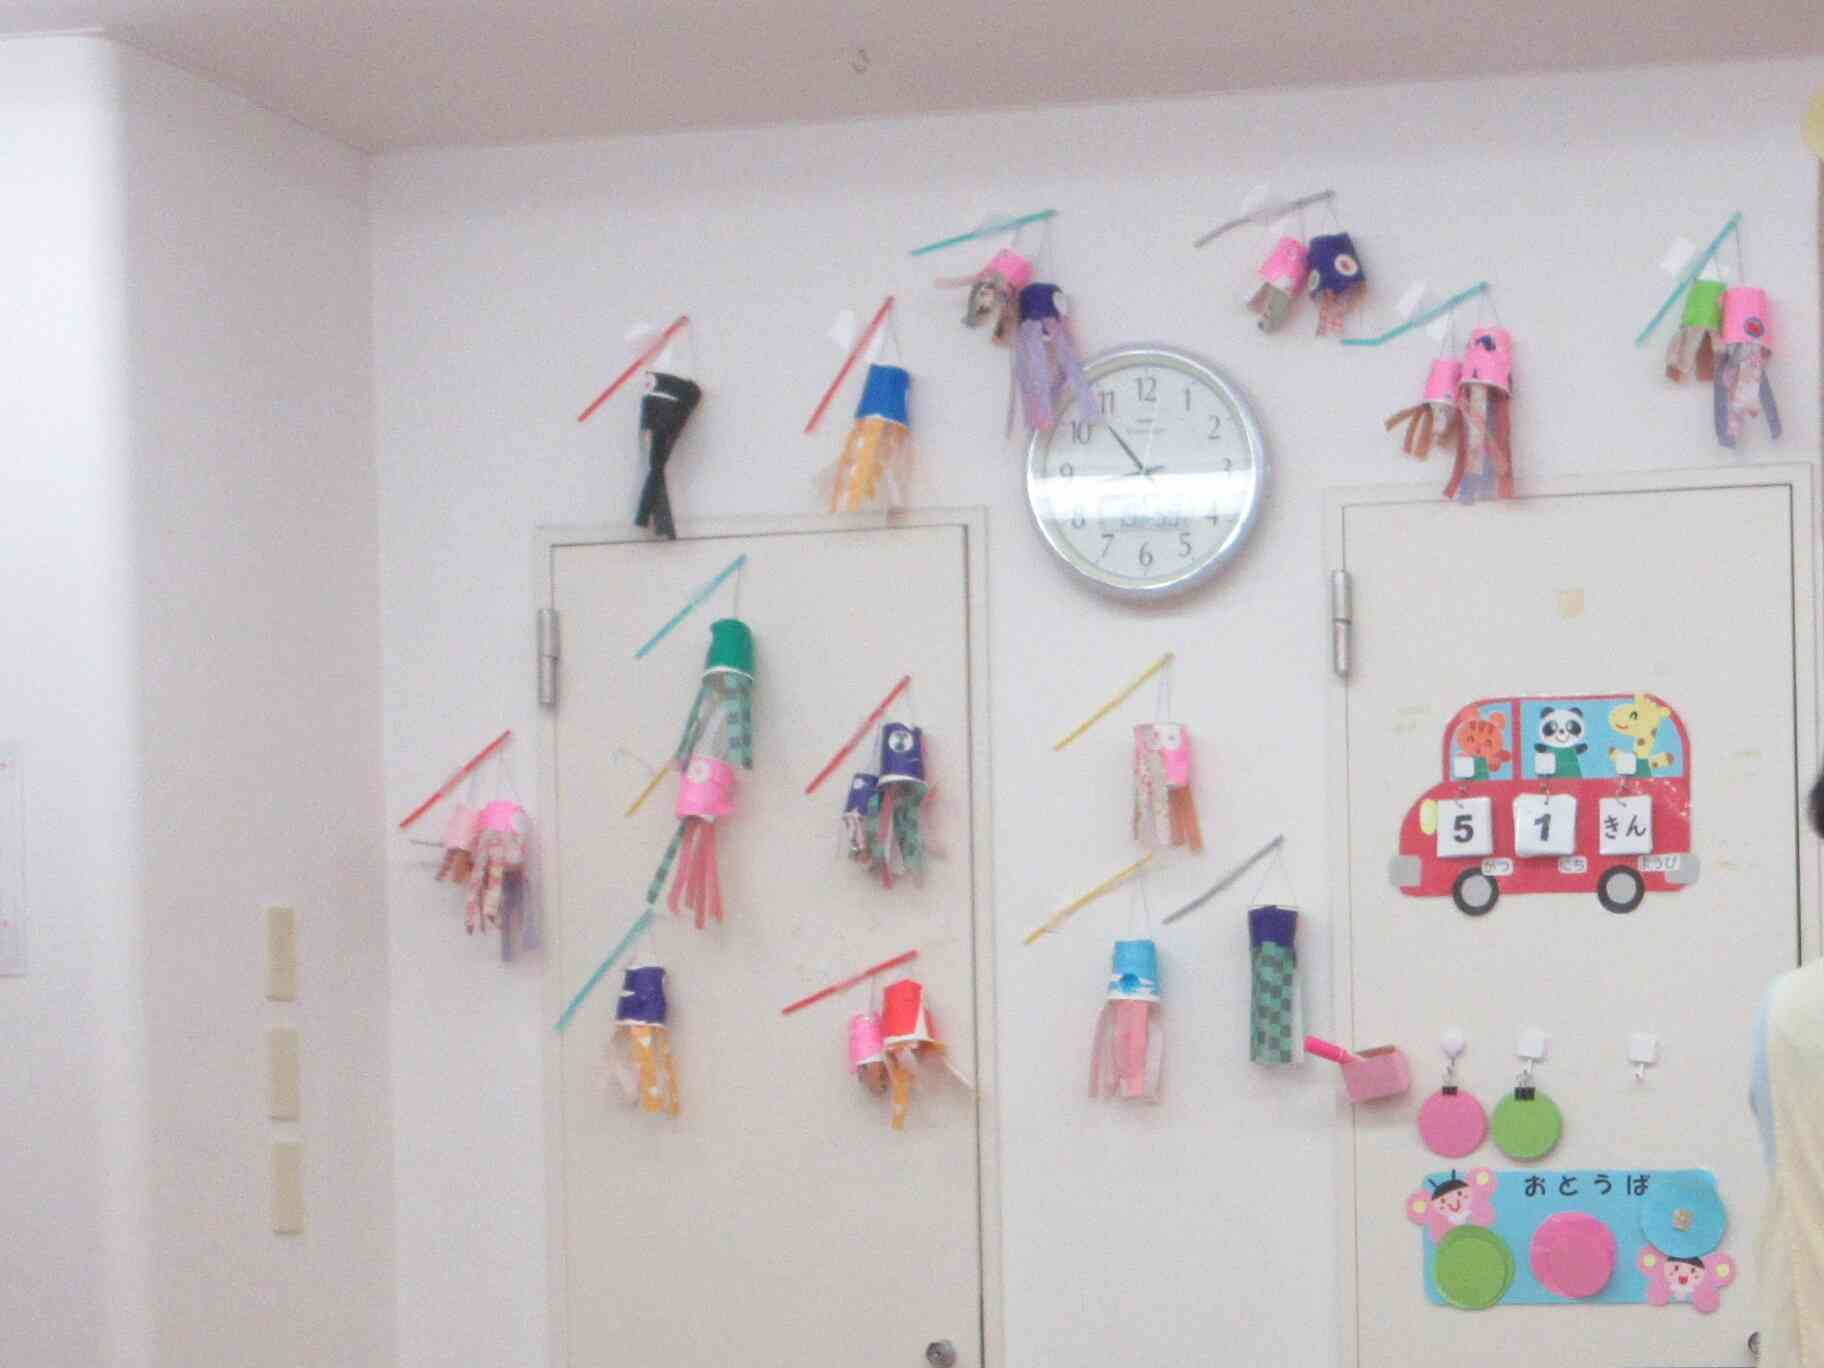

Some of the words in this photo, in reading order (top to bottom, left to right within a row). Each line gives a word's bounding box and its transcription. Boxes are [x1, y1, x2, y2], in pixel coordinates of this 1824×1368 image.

[1136, 377, 1157, 402] 12
[1184, 388, 1192, 411] 1
[1099, 391, 1115, 415] 11
[1070, 421, 1092, 445] 10
[1208, 416, 1221, 440] 2
[1101, 534, 1115, 558] 7
[1138, 542, 1153, 567] 6
[1179, 532, 1192, 557] 5
[1453, 815, 1475, 843] 5
[1534, 814, 1551, 840] 1
[1603, 815, 1647, 839] きん
[1524, 1174, 1650, 1197] おとうば
